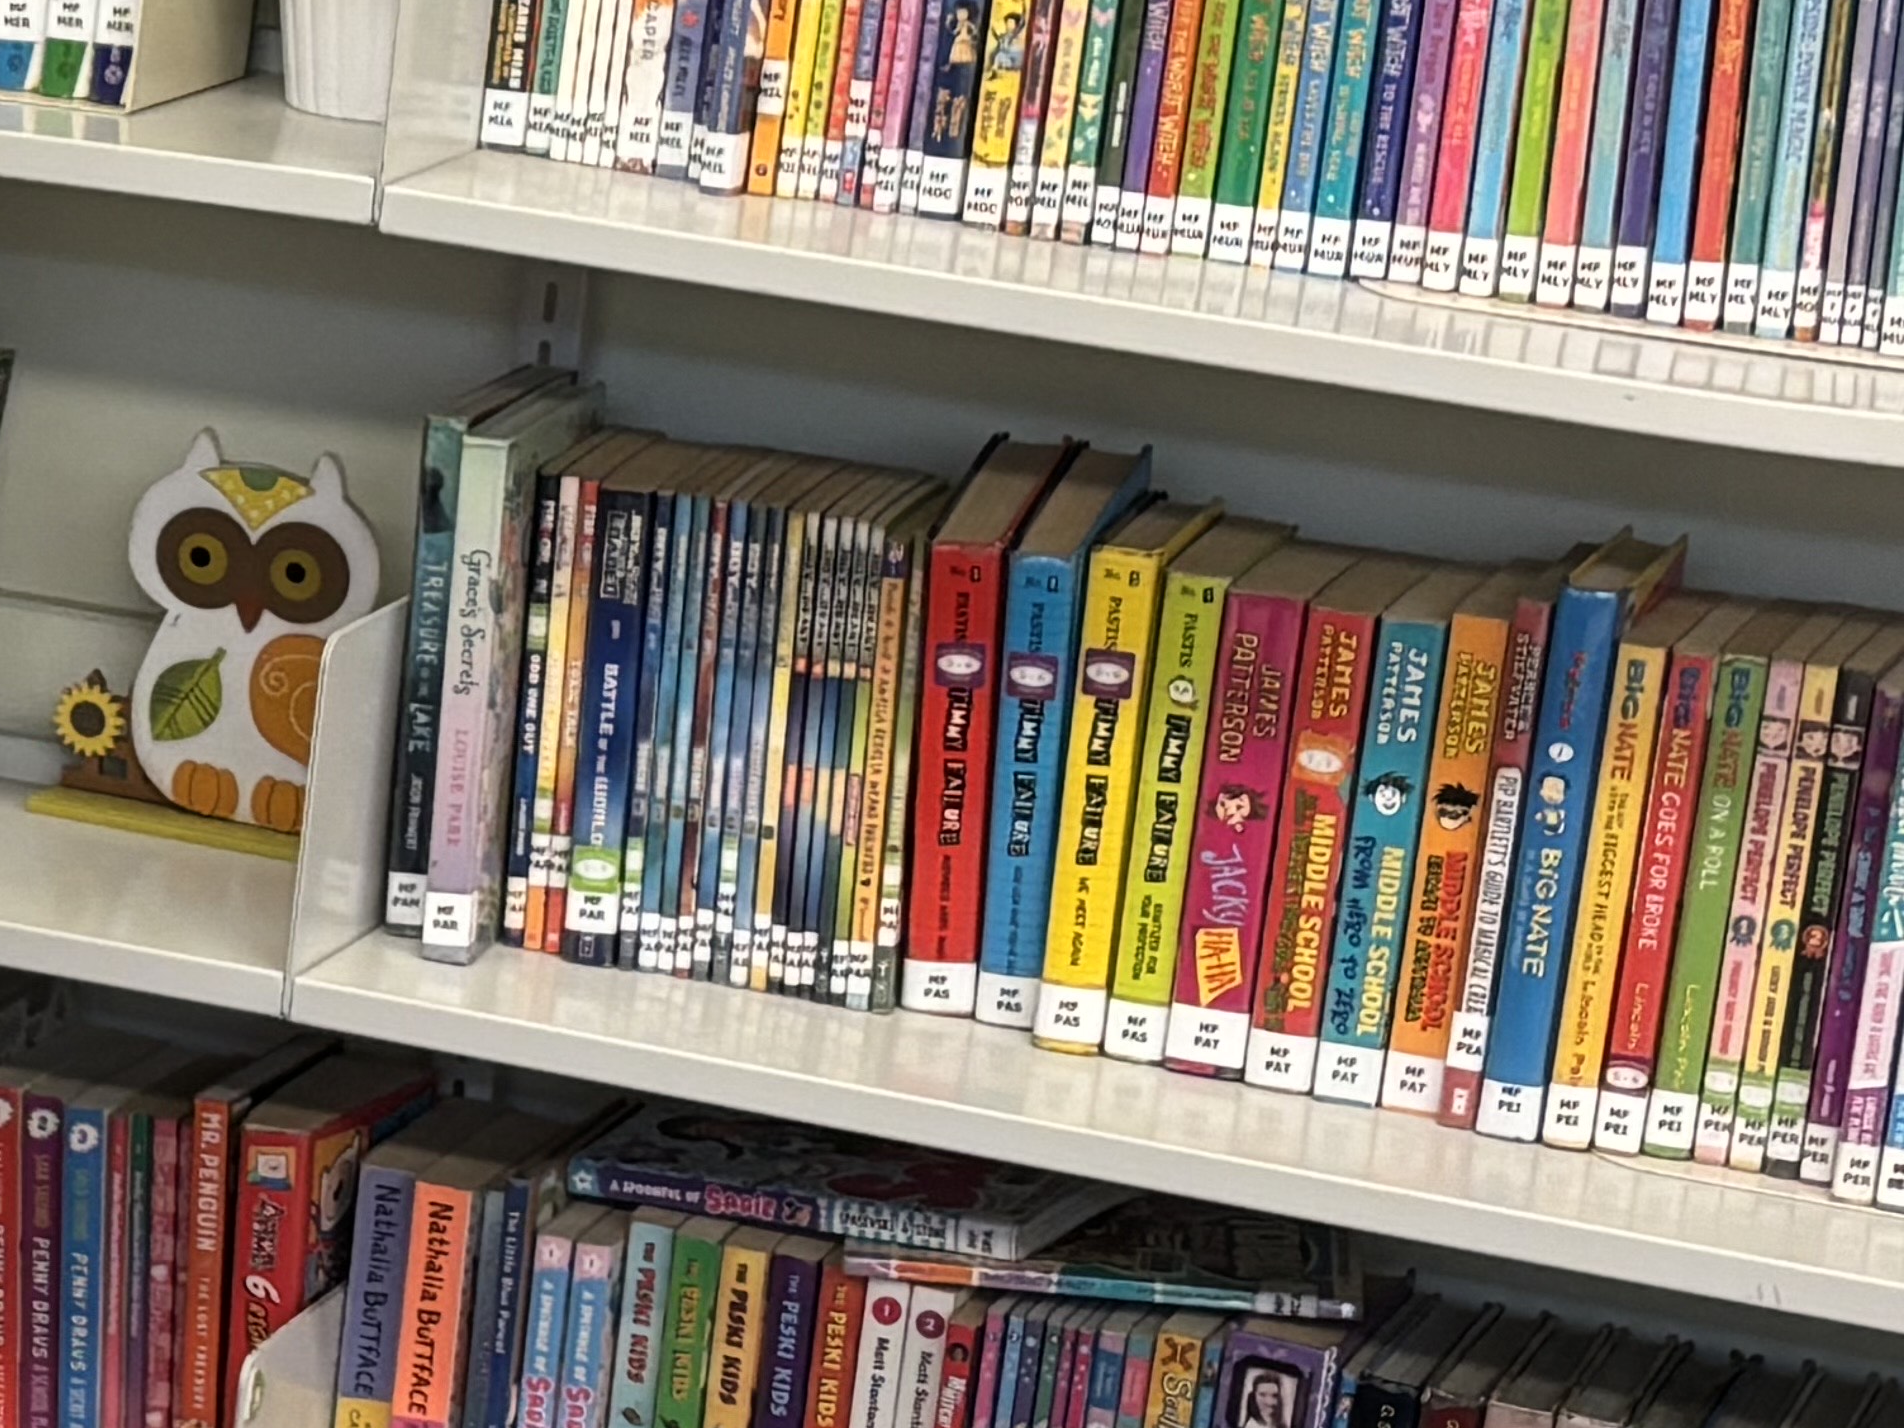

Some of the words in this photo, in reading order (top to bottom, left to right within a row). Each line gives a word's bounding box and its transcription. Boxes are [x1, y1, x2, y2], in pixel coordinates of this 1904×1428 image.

[413, 560, 449, 668] TREASURE
[458, 547, 492, 620] Grace's
[1178, 612, 1199, 669] PASTIS
[1308, 622, 1336, 721] PATTERSON
[1327, 627, 1361, 720] JAMES
[405, 703, 432, 756] LAKE
[598, 662, 621, 738] BATTLE
[1218, 630, 1260, 765] PATTERSON
[1251, 662, 1283, 740] JAMES
[1375, 640, 1405, 747] PATTERSON
[1396, 645, 1431, 746] JAMES
[1464, 657, 1499, 758] JAMES
[1157, 713, 1193, 785] TIMMY
[1610, 722, 1641, 784] NATE
[1662, 728, 1693, 791] NATE
[1714, 729, 1743, 792] NATE
[936, 758, 967, 847] FAILURE
[1006, 769, 1038, 858] FAILURE
[1074, 773, 1110, 868] FAILURE
[1142, 790, 1180, 885] FAILURE
[1655, 791, 1682, 848] GOES
[1709, 793, 1732, 825] ON
[1197, 841, 1249, 928] JACKY
[1302, 812, 1340, 910] MIDDLE
[1372, 845, 1407, 940] MIDDLE
[1442, 849, 1472, 944] MIDDLE
[1649, 849, 1672, 890] FOR
[1286, 910, 1321, 1015] SCHOOL
[1522, 901, 1558, 978] NATE
[1355, 941, 1392, 1039] SCHOOL
[1193, 1036, 1221, 1051] PAT
[1331, 1068, 1359, 1084] PAT
[194, 1155, 220, 1253] PENGUIN
[363, 1182, 404, 1289] Nathalia
[31, 1235, 52, 1289] PENNY
[416, 1198, 455, 1304] Nathalia
[626, 1326, 651, 1386] KIDS
[724, 1286, 750, 1353] PESKI
[775, 1297, 801, 1366] PESKI
[823, 1309, 850, 1375] PESKI
[717, 1352, 745, 1408] KIDS
[768, 1365, 794, 1419] KIDS
